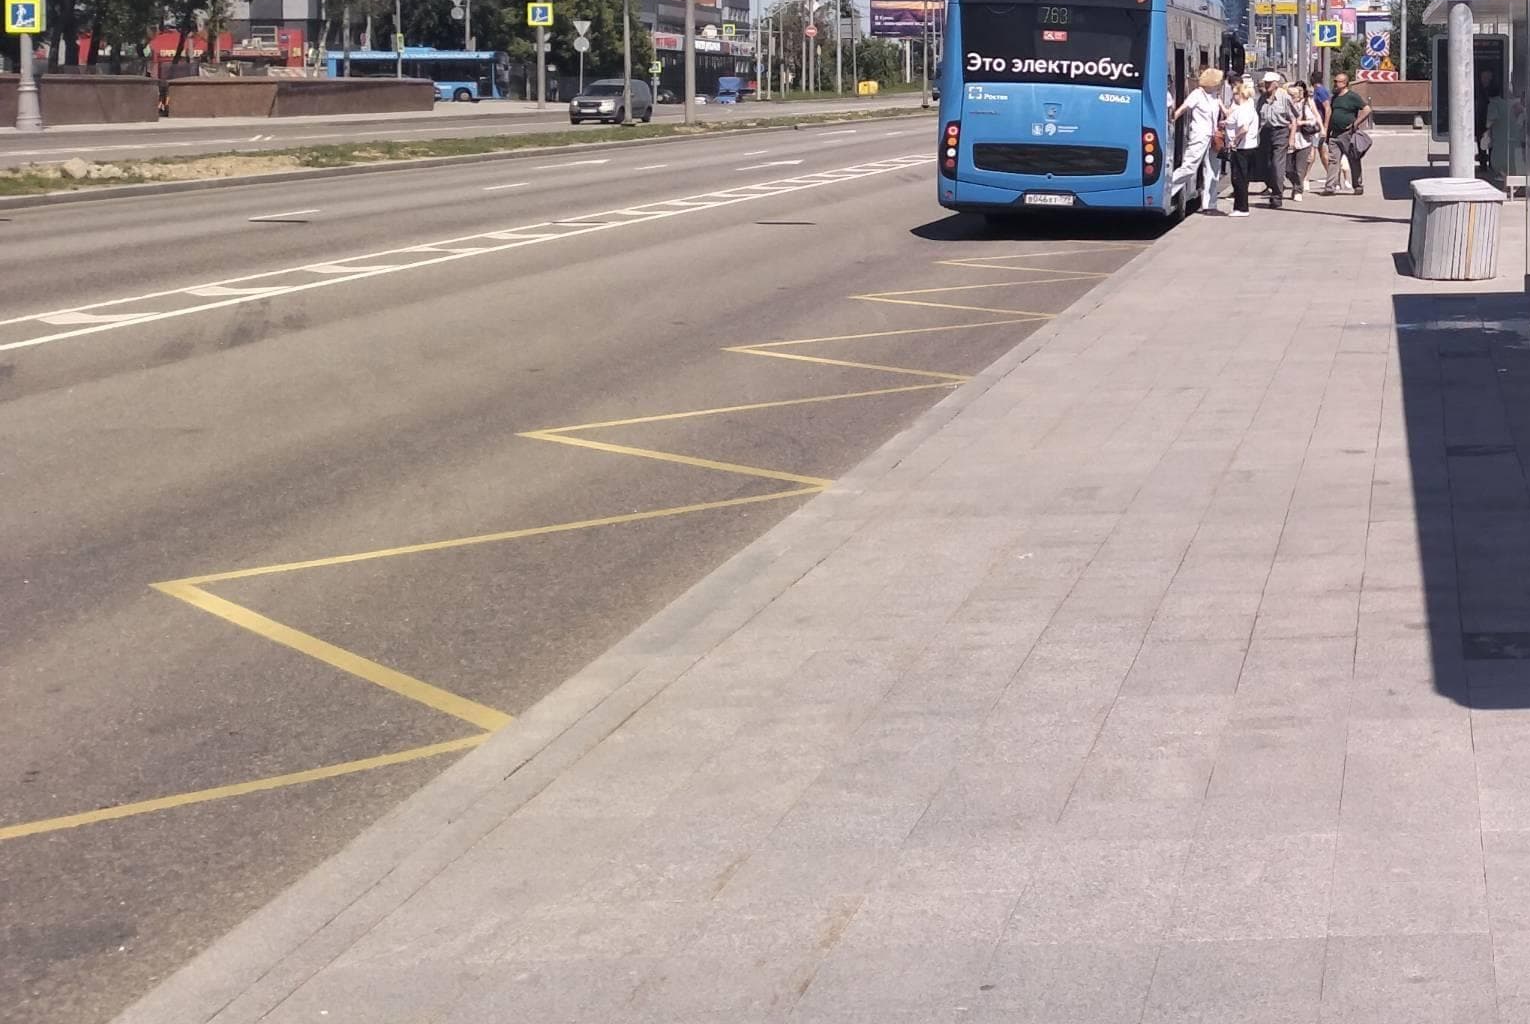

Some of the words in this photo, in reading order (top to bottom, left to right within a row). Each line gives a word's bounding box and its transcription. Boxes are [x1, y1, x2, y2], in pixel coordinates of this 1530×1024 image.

[1042, 7, 1068, 24] 763
[967, 52, 1005, 71] Это
[1011, 57, 1139, 79] электробус.
